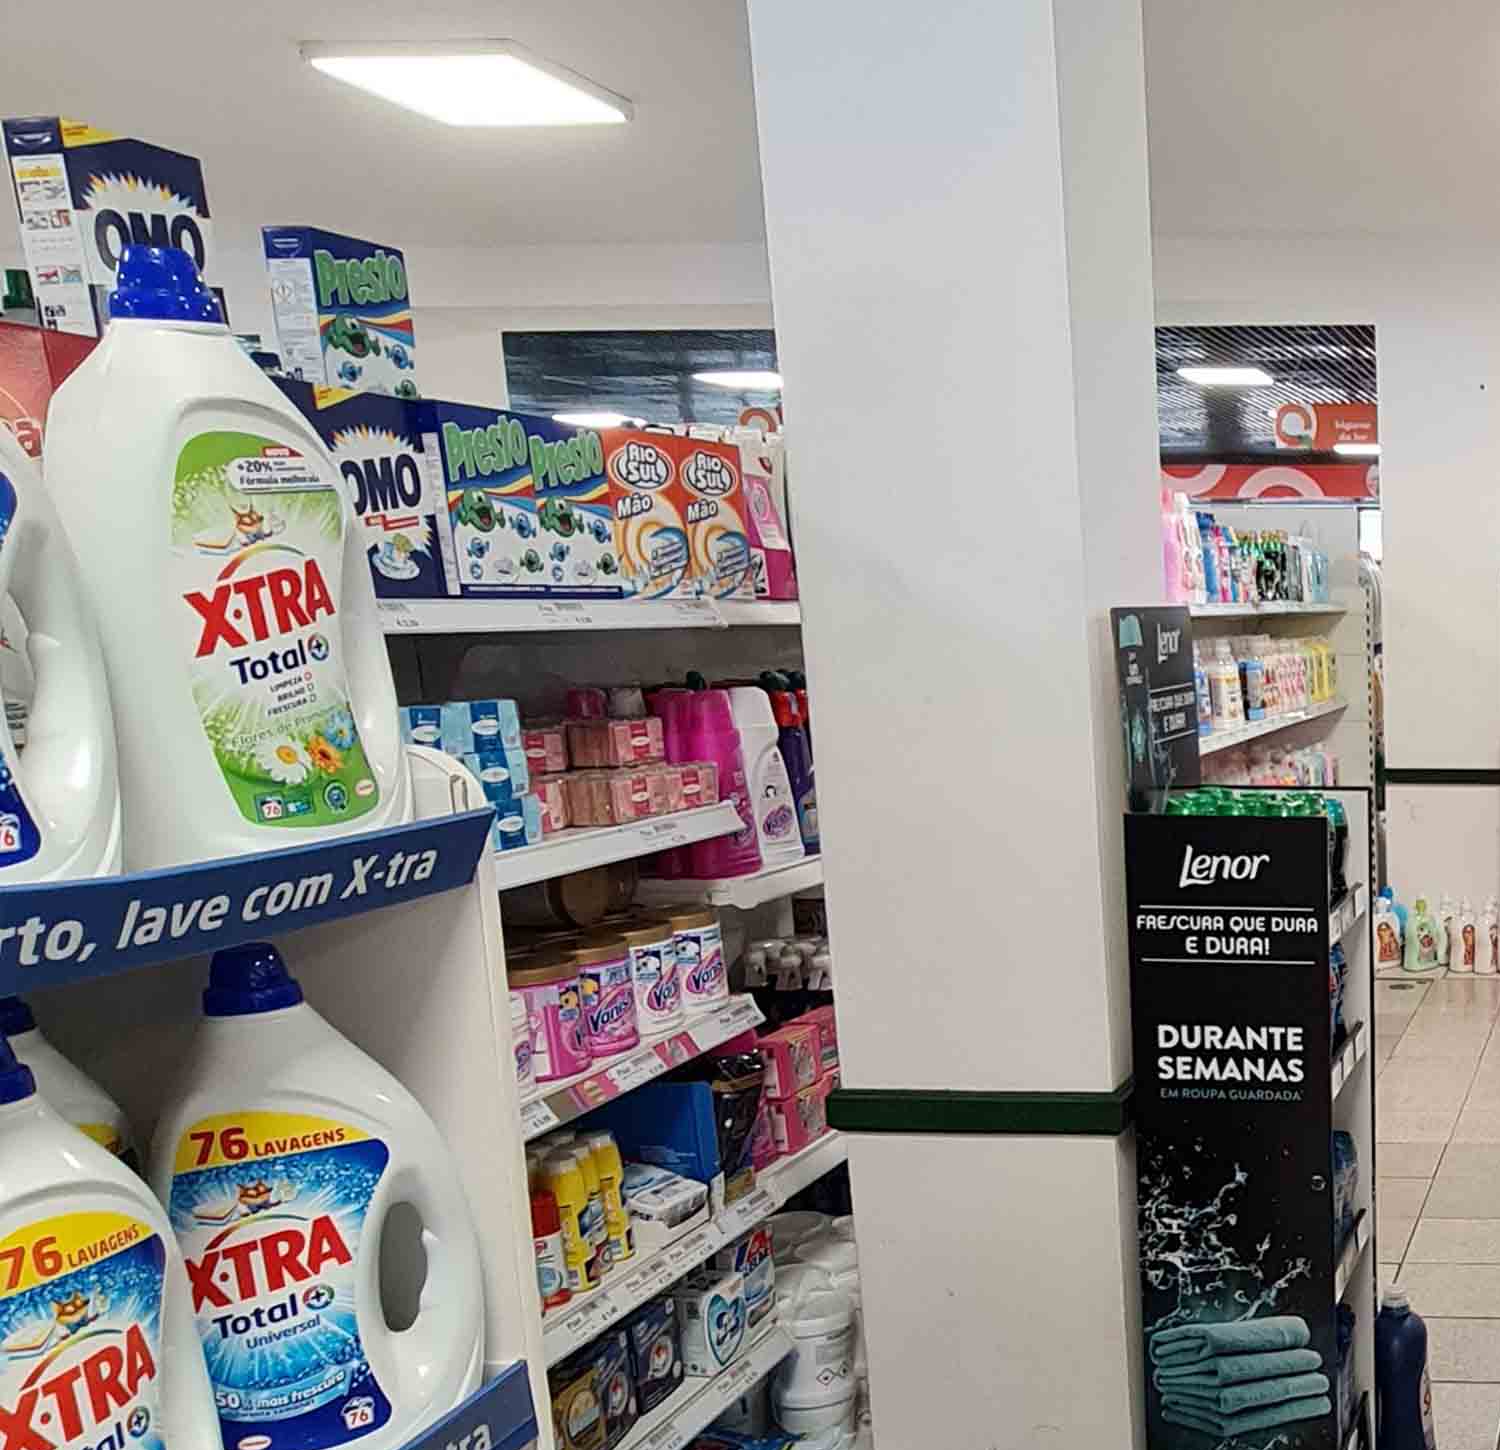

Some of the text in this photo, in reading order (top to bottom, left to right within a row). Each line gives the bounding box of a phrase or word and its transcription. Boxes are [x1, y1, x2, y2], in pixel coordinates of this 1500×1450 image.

[314, 249, 406, 307] Presto
[443, 416, 528, 482] Presto
[529, 429, 602, 492] Presto
[628, 443, 656, 464] RIO
[696, 452, 721, 472] RIO
[626, 461, 661, 483] SUL
[693, 468, 723, 492] SUL
[617, 493, 653, 520] Mão
[687, 499, 719, 523] Mão
[230, 639, 307, 684] Total
[1178, 843, 1271, 888] Lenor
[116, 900, 228, 951] lave
[241, 871, 334, 921] com
[340, 848, 438, 900] X-tra
[1136, 914, 1318, 934] FRESCURA QUE DURA
[1185, 936, 1270, 956] E DURA!
[1158, 1024, 1304, 1051] DURANTE
[1158, 1055, 1304, 1083] SEMANAS
[1160, 1087, 1302, 1101] EM ROUPA GUARDADA
[190, 1127, 345, 1166] 76 LAVAGENS
[0, 1223, 140, 1291] 76 LAVAGENS
[212, 1293, 299, 1340] Total
[246, 1313, 321, 1350] Universal
[215, 1391, 241, 1409] 50
[290, 1370, 346, 1402] frescura
[350, 1410, 369, 1426] 76
